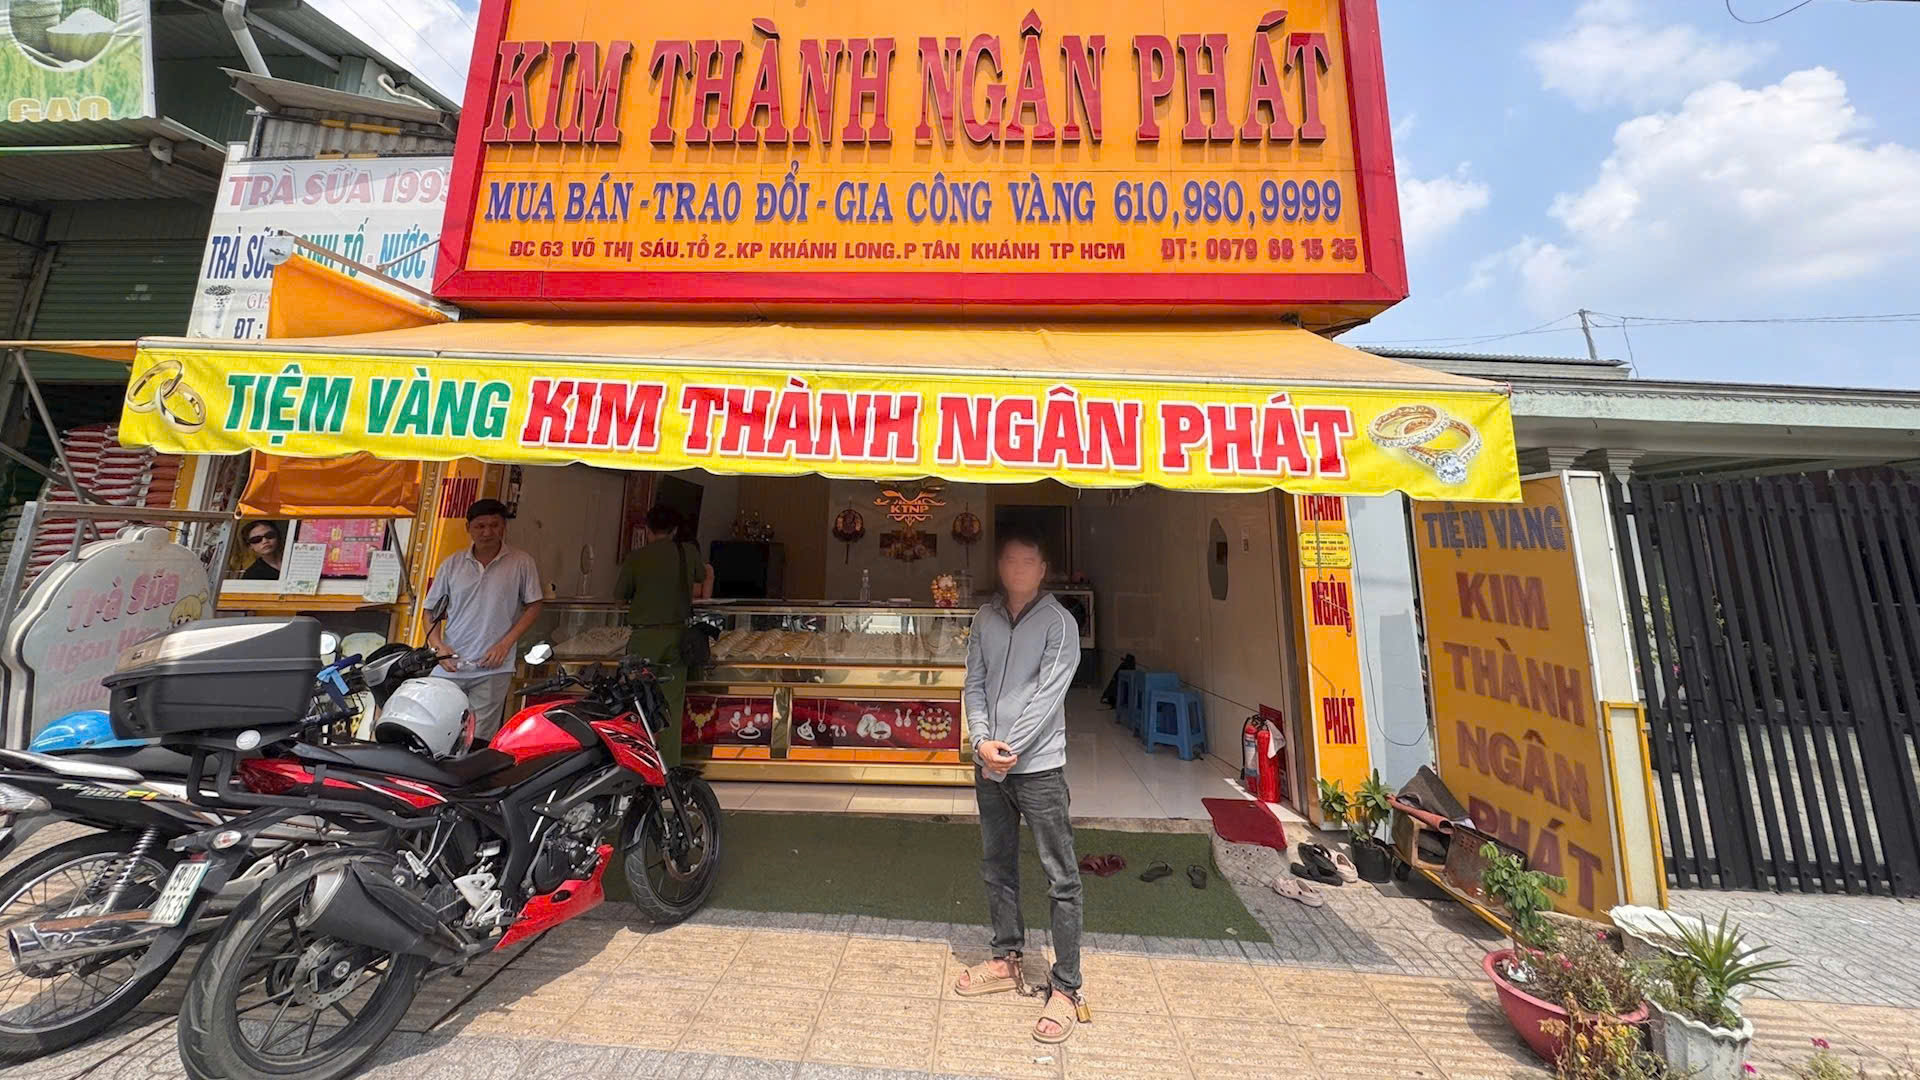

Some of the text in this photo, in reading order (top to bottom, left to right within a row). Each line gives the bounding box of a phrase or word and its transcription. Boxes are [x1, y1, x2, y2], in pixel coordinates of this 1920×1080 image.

[483, 8, 1332, 145] KIM THÀNH NGÂN PHÁT
[228, 165, 296, 205] TRÀ
[302, 165, 373, 205] SỮA
[484, 181, 556, 222] MUA
[564, 172, 633, 222] BÁN
[755, 160, 810, 223] ĐỔI
[834, 181, 894, 223] GIA
[906, 172, 992, 224] CÔNG
[1008, 172, 1096, 224] VÀNG
[206, 226, 241, 279] TRÀ
[341, 217, 370, 278] TỐ
[378, 223, 430, 279] NƯỚC
[509, 240, 536, 257] ĐC
[540, 240, 563, 257] 63
[571, 237, 596, 258] VÕ
[603, 240, 634, 263] THỊ
[769, 238, 838, 259] KHÁNH
[922, 239, 960, 260] TÂN
[971, 238, 1040, 260] KHÁNH
[1050, 242, 1074, 260] TP
[1080, 242, 1126, 260] HCM
[1206, 238, 1258, 260] 0979
[1301, 238, 1324, 260] 15
[1331, 238, 1358, 260] 35
[225, 365, 1350, 475] TIỆM VÀNG KIM THÀNH NGÂN PHÁT
[891, 505, 929, 513] KTNP
[1422, 501, 1488, 557] TIỆM
[1311, 573, 1348, 626] NGÂN
[1456, 571, 1550, 631] KIM
[1443, 637, 1586, 728] THÀNH
[1322, 689, 1357, 744] PHÁT
[1456, 719, 1592, 822] NGÂN
